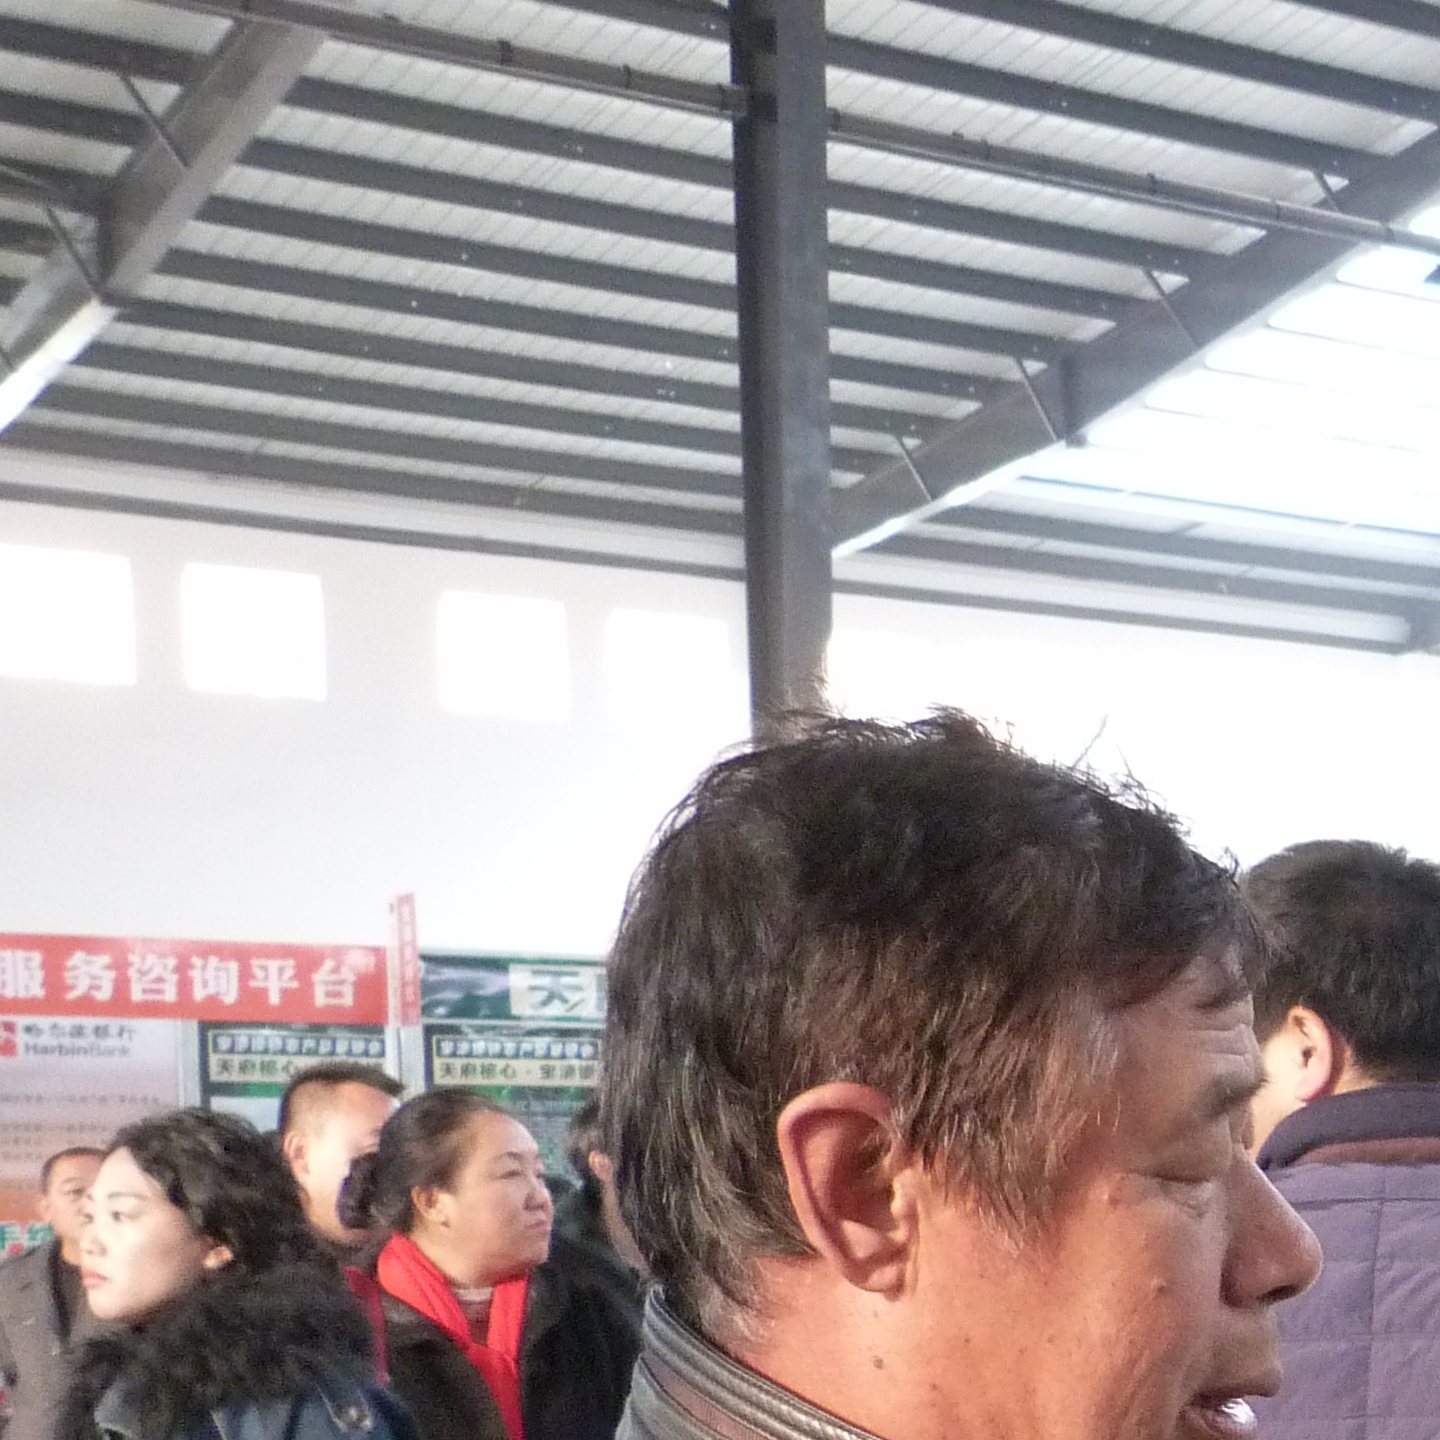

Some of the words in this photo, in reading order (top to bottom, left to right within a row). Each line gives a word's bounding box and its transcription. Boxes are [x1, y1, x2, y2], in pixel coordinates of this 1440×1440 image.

[0, 949, 357, 1008] 服务咨询平台
